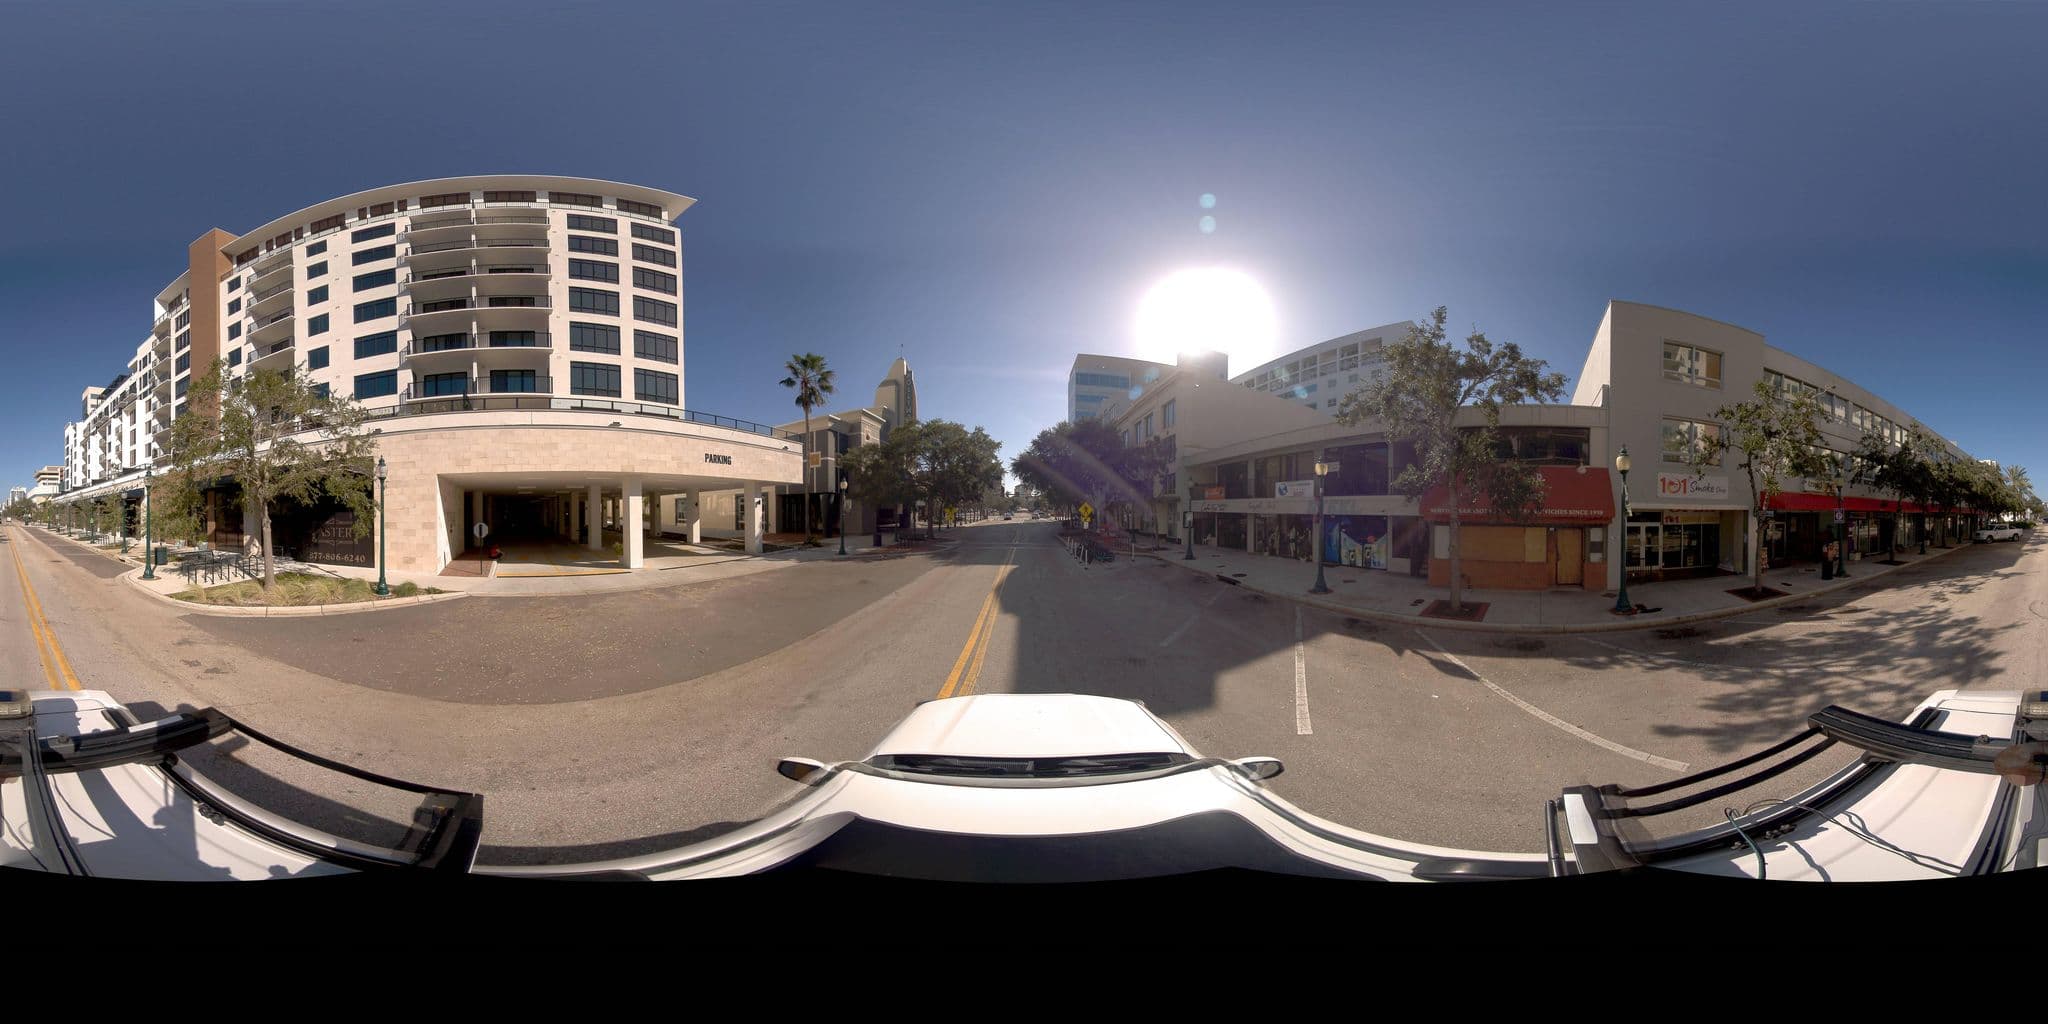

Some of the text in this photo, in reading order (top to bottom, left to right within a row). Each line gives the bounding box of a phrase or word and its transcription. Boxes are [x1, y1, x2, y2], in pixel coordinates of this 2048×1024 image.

[704, 453, 732, 465] PARKING
[1660, 477, 1687, 494] 101
[1690, 480, 1715, 493] Smoke
